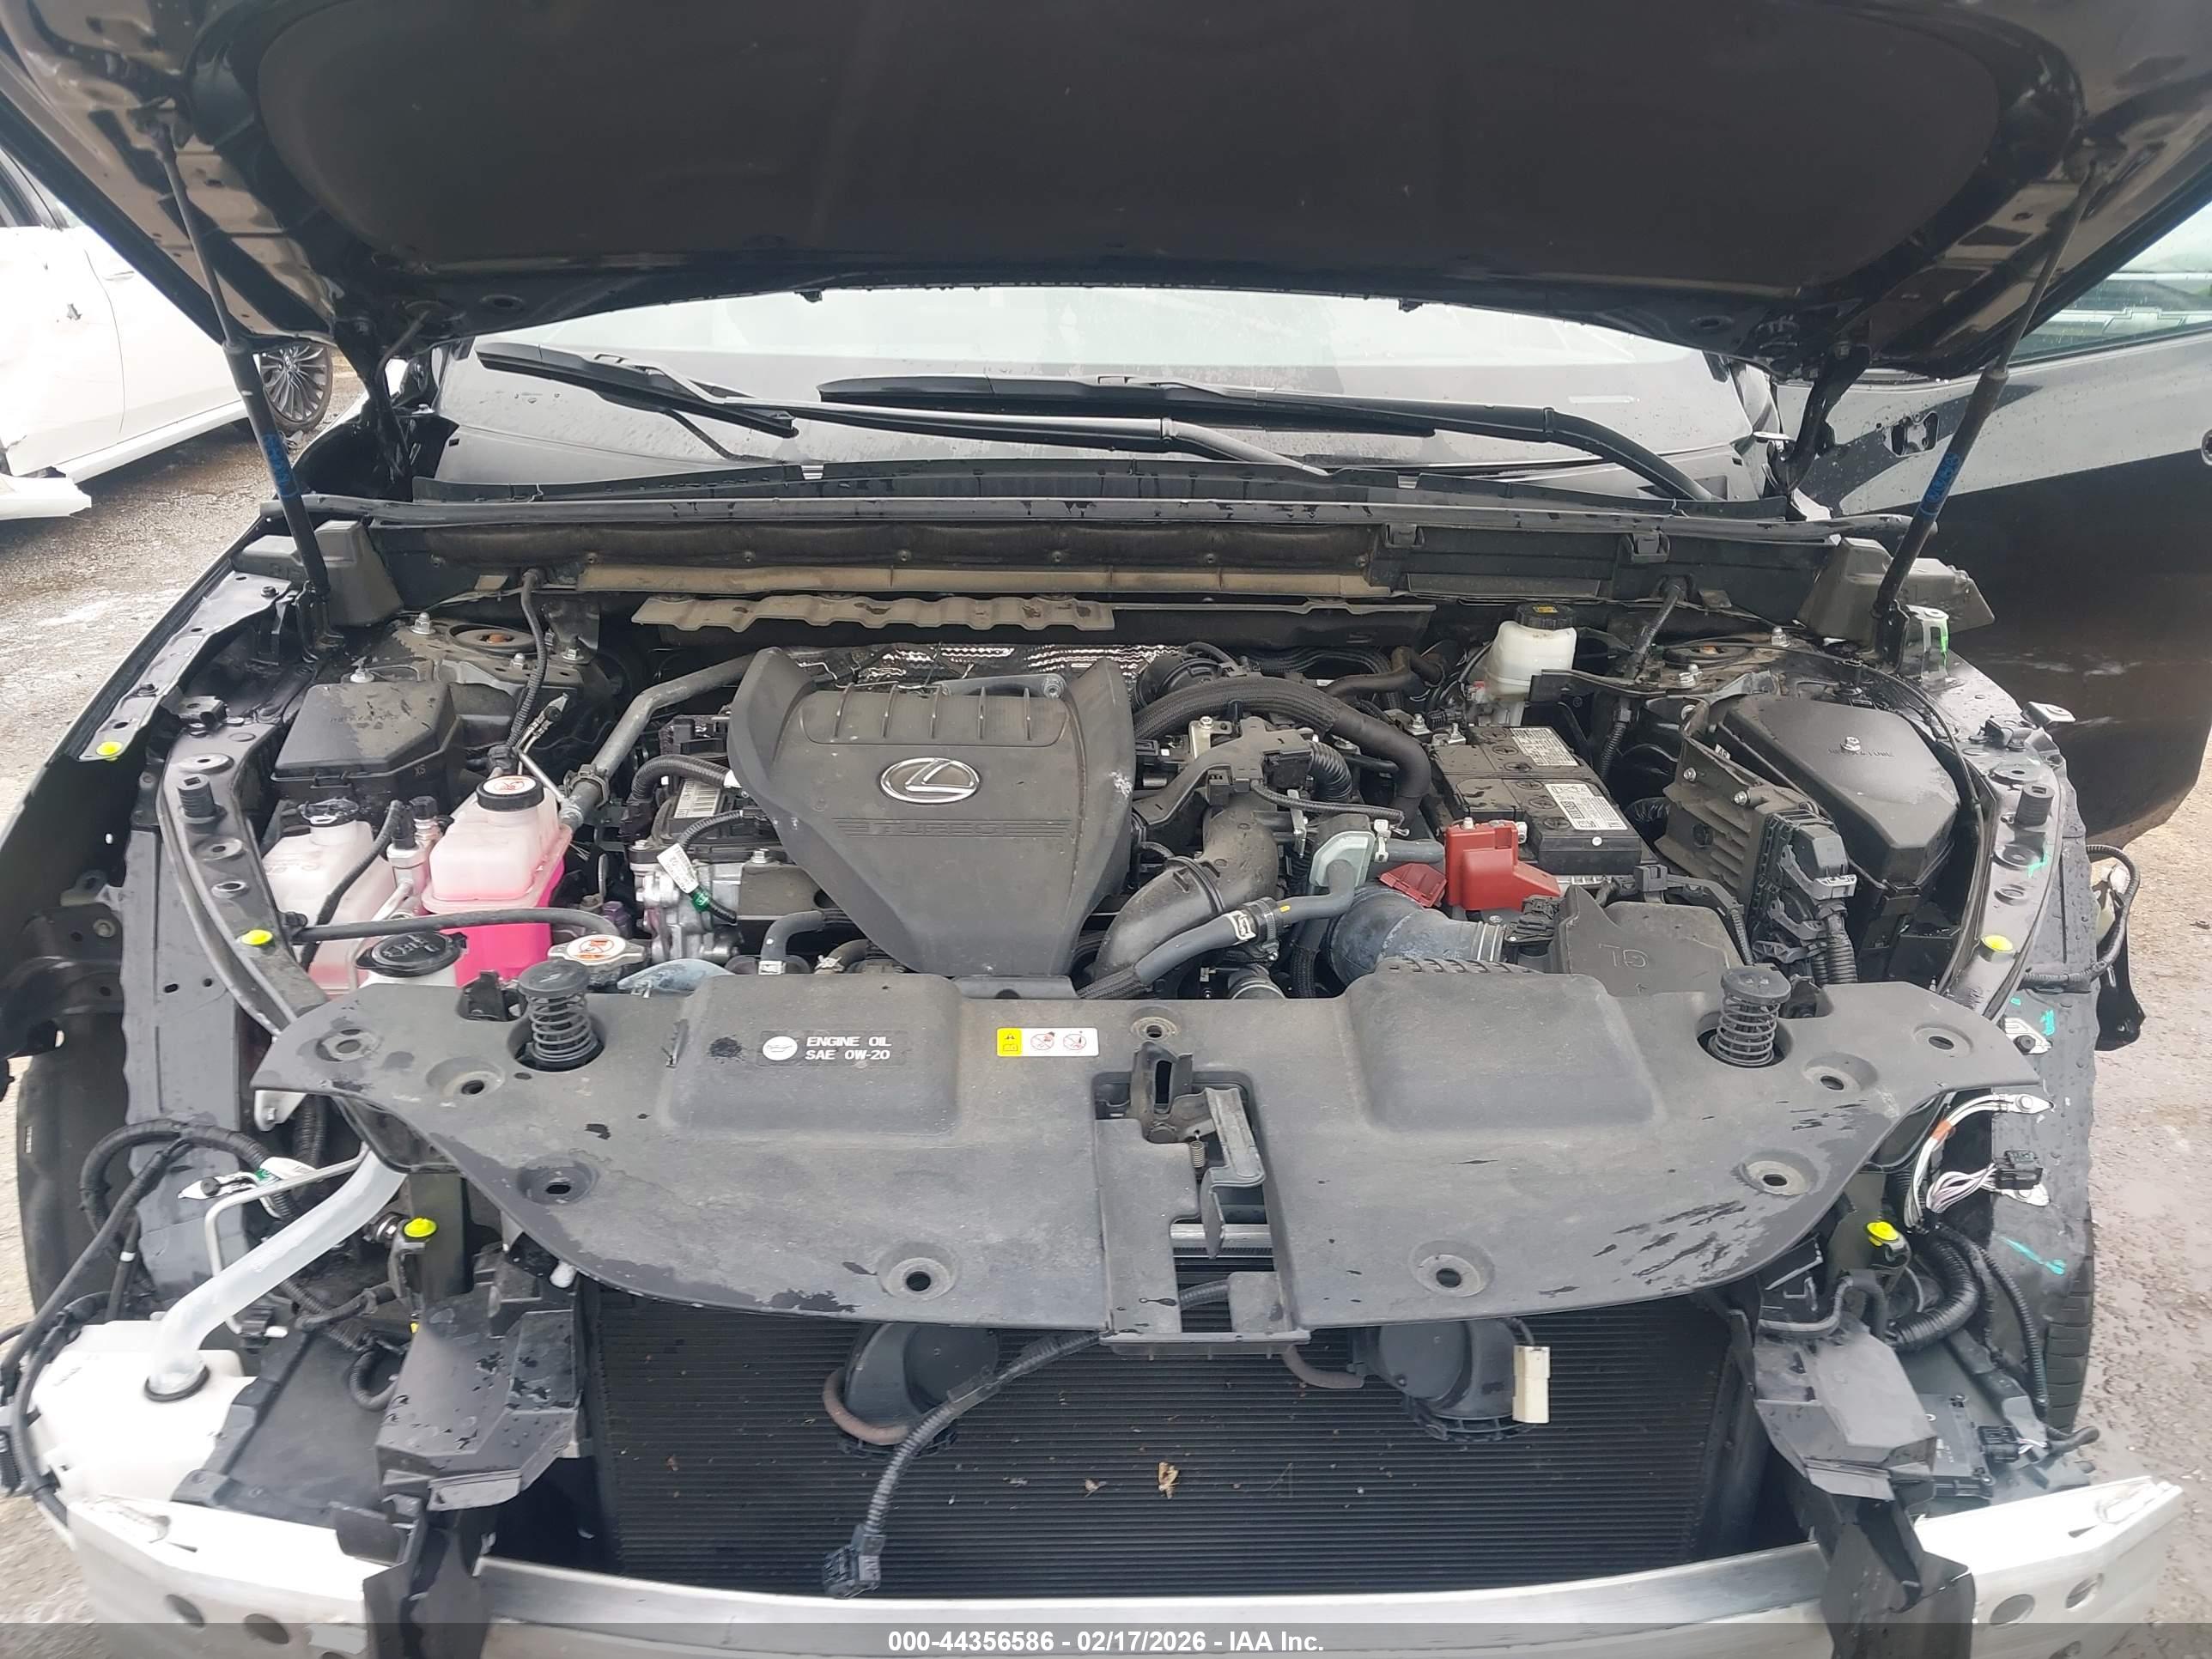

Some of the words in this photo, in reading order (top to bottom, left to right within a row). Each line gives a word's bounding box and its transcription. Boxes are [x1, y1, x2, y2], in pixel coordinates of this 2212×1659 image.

[806, 1036, 861, 1047] ENGINE
[868, 1036, 892, 1047] OIL
[805, 1049, 837, 1060] SAE
[844, 1049, 890, 1060] 0W-20
